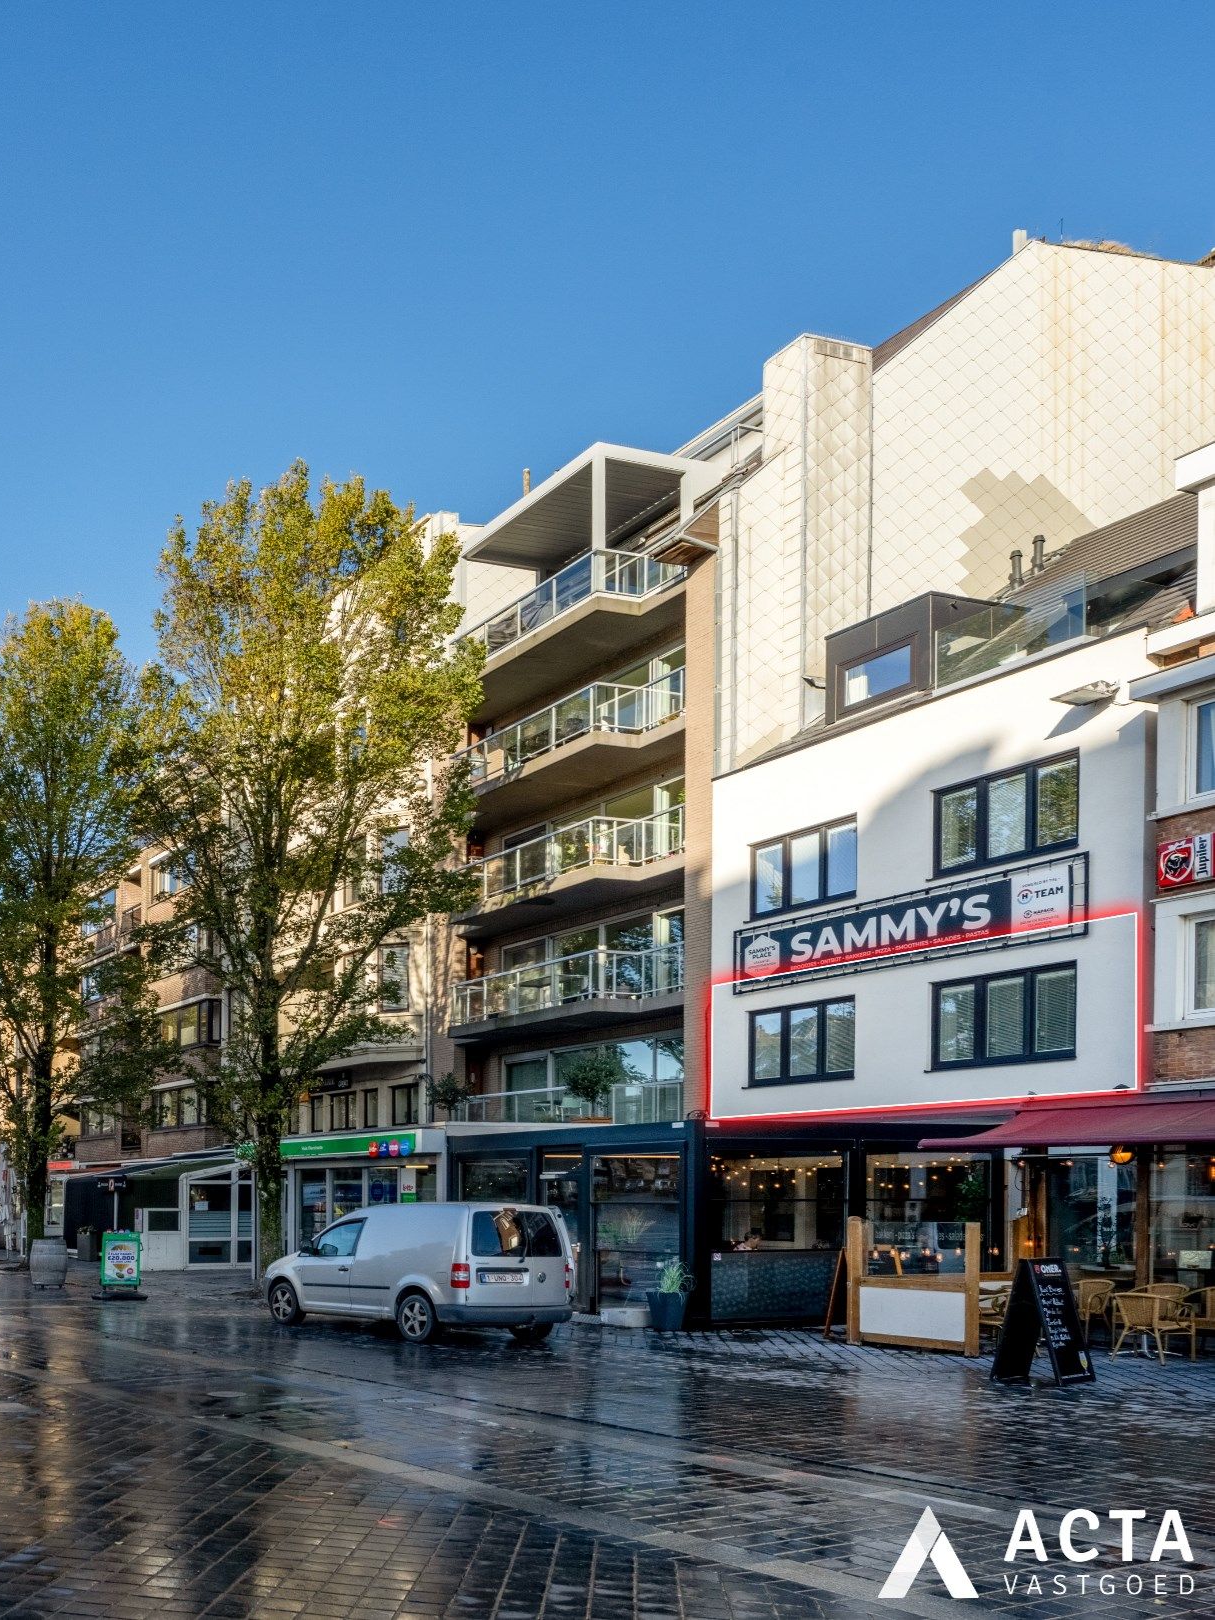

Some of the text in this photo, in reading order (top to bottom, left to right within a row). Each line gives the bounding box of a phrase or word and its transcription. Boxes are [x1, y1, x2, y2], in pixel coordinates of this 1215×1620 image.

[1196, 836, 1210, 877] Jupiler
[1034, 885, 1064, 899] TEAM
[790, 894, 991, 963] SAMMY'S
[748, 945, 776, 955] SAMMY'S
[875, 946, 891, 955] PIZZA
[895, 940, 929, 951] SMOOTHIES
[932, 934, 961, 944] SALADES
[965, 929, 990, 939] PASTAS
[752, 952, 773, 960] PLACE
